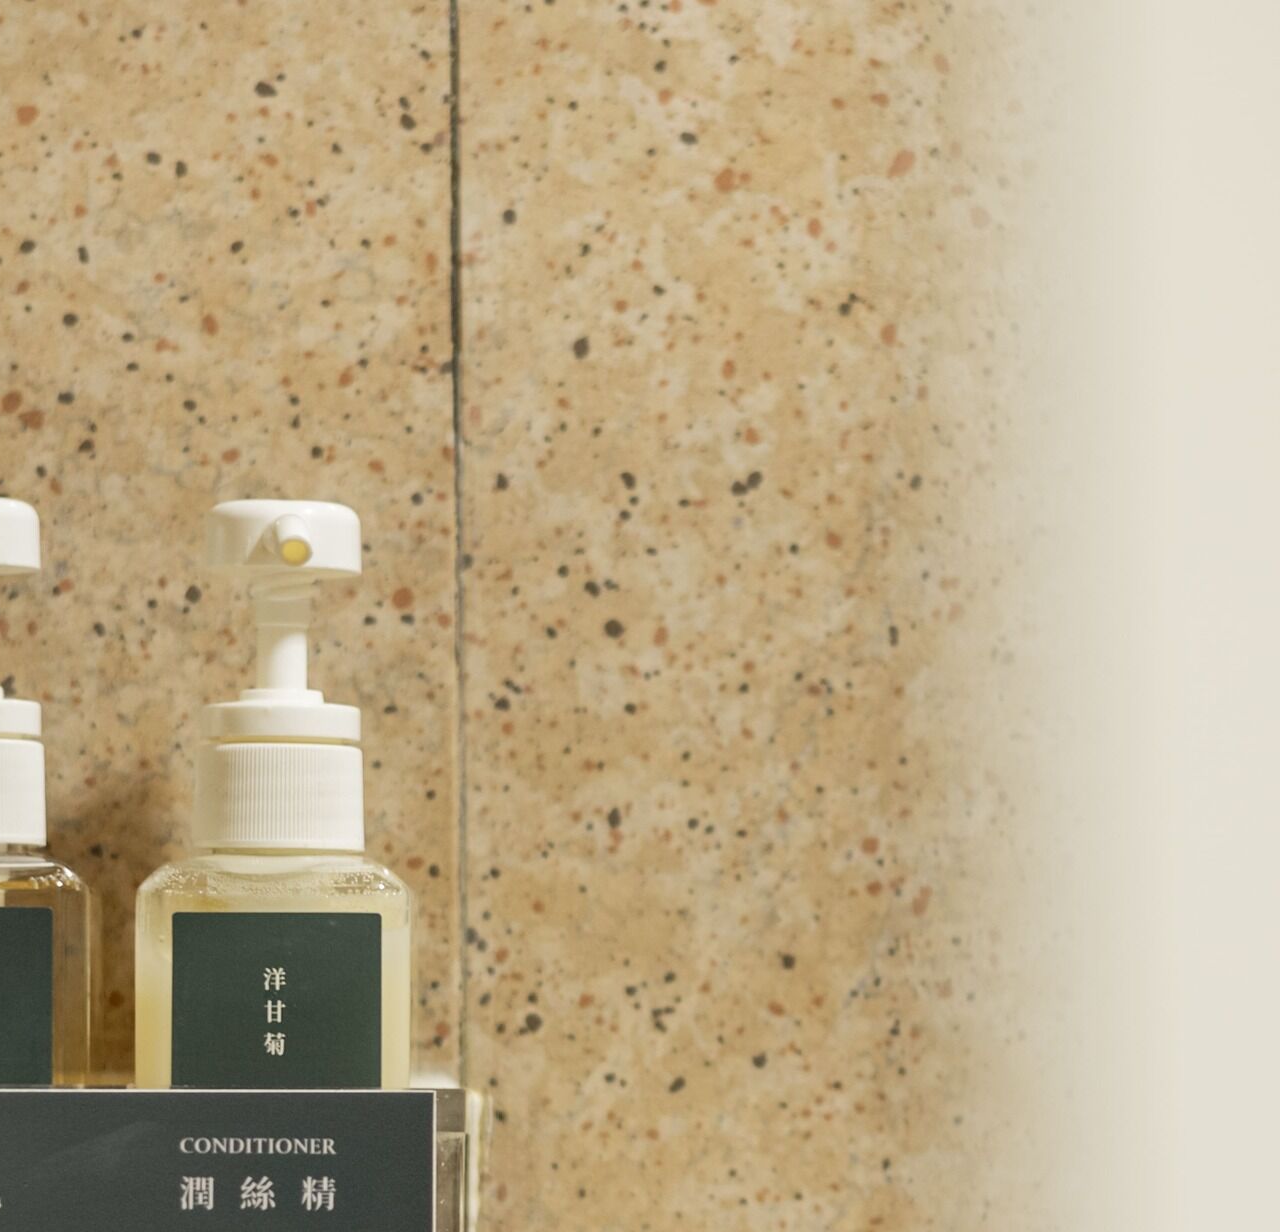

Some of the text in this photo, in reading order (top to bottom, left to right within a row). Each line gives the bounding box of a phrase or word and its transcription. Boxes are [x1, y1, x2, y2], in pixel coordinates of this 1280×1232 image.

[263, 967, 287, 1056] 洋甘菊
[179, 1137, 337, 1155] CONDITIONER
[180, 1175, 337, 1211] 潤絲精
